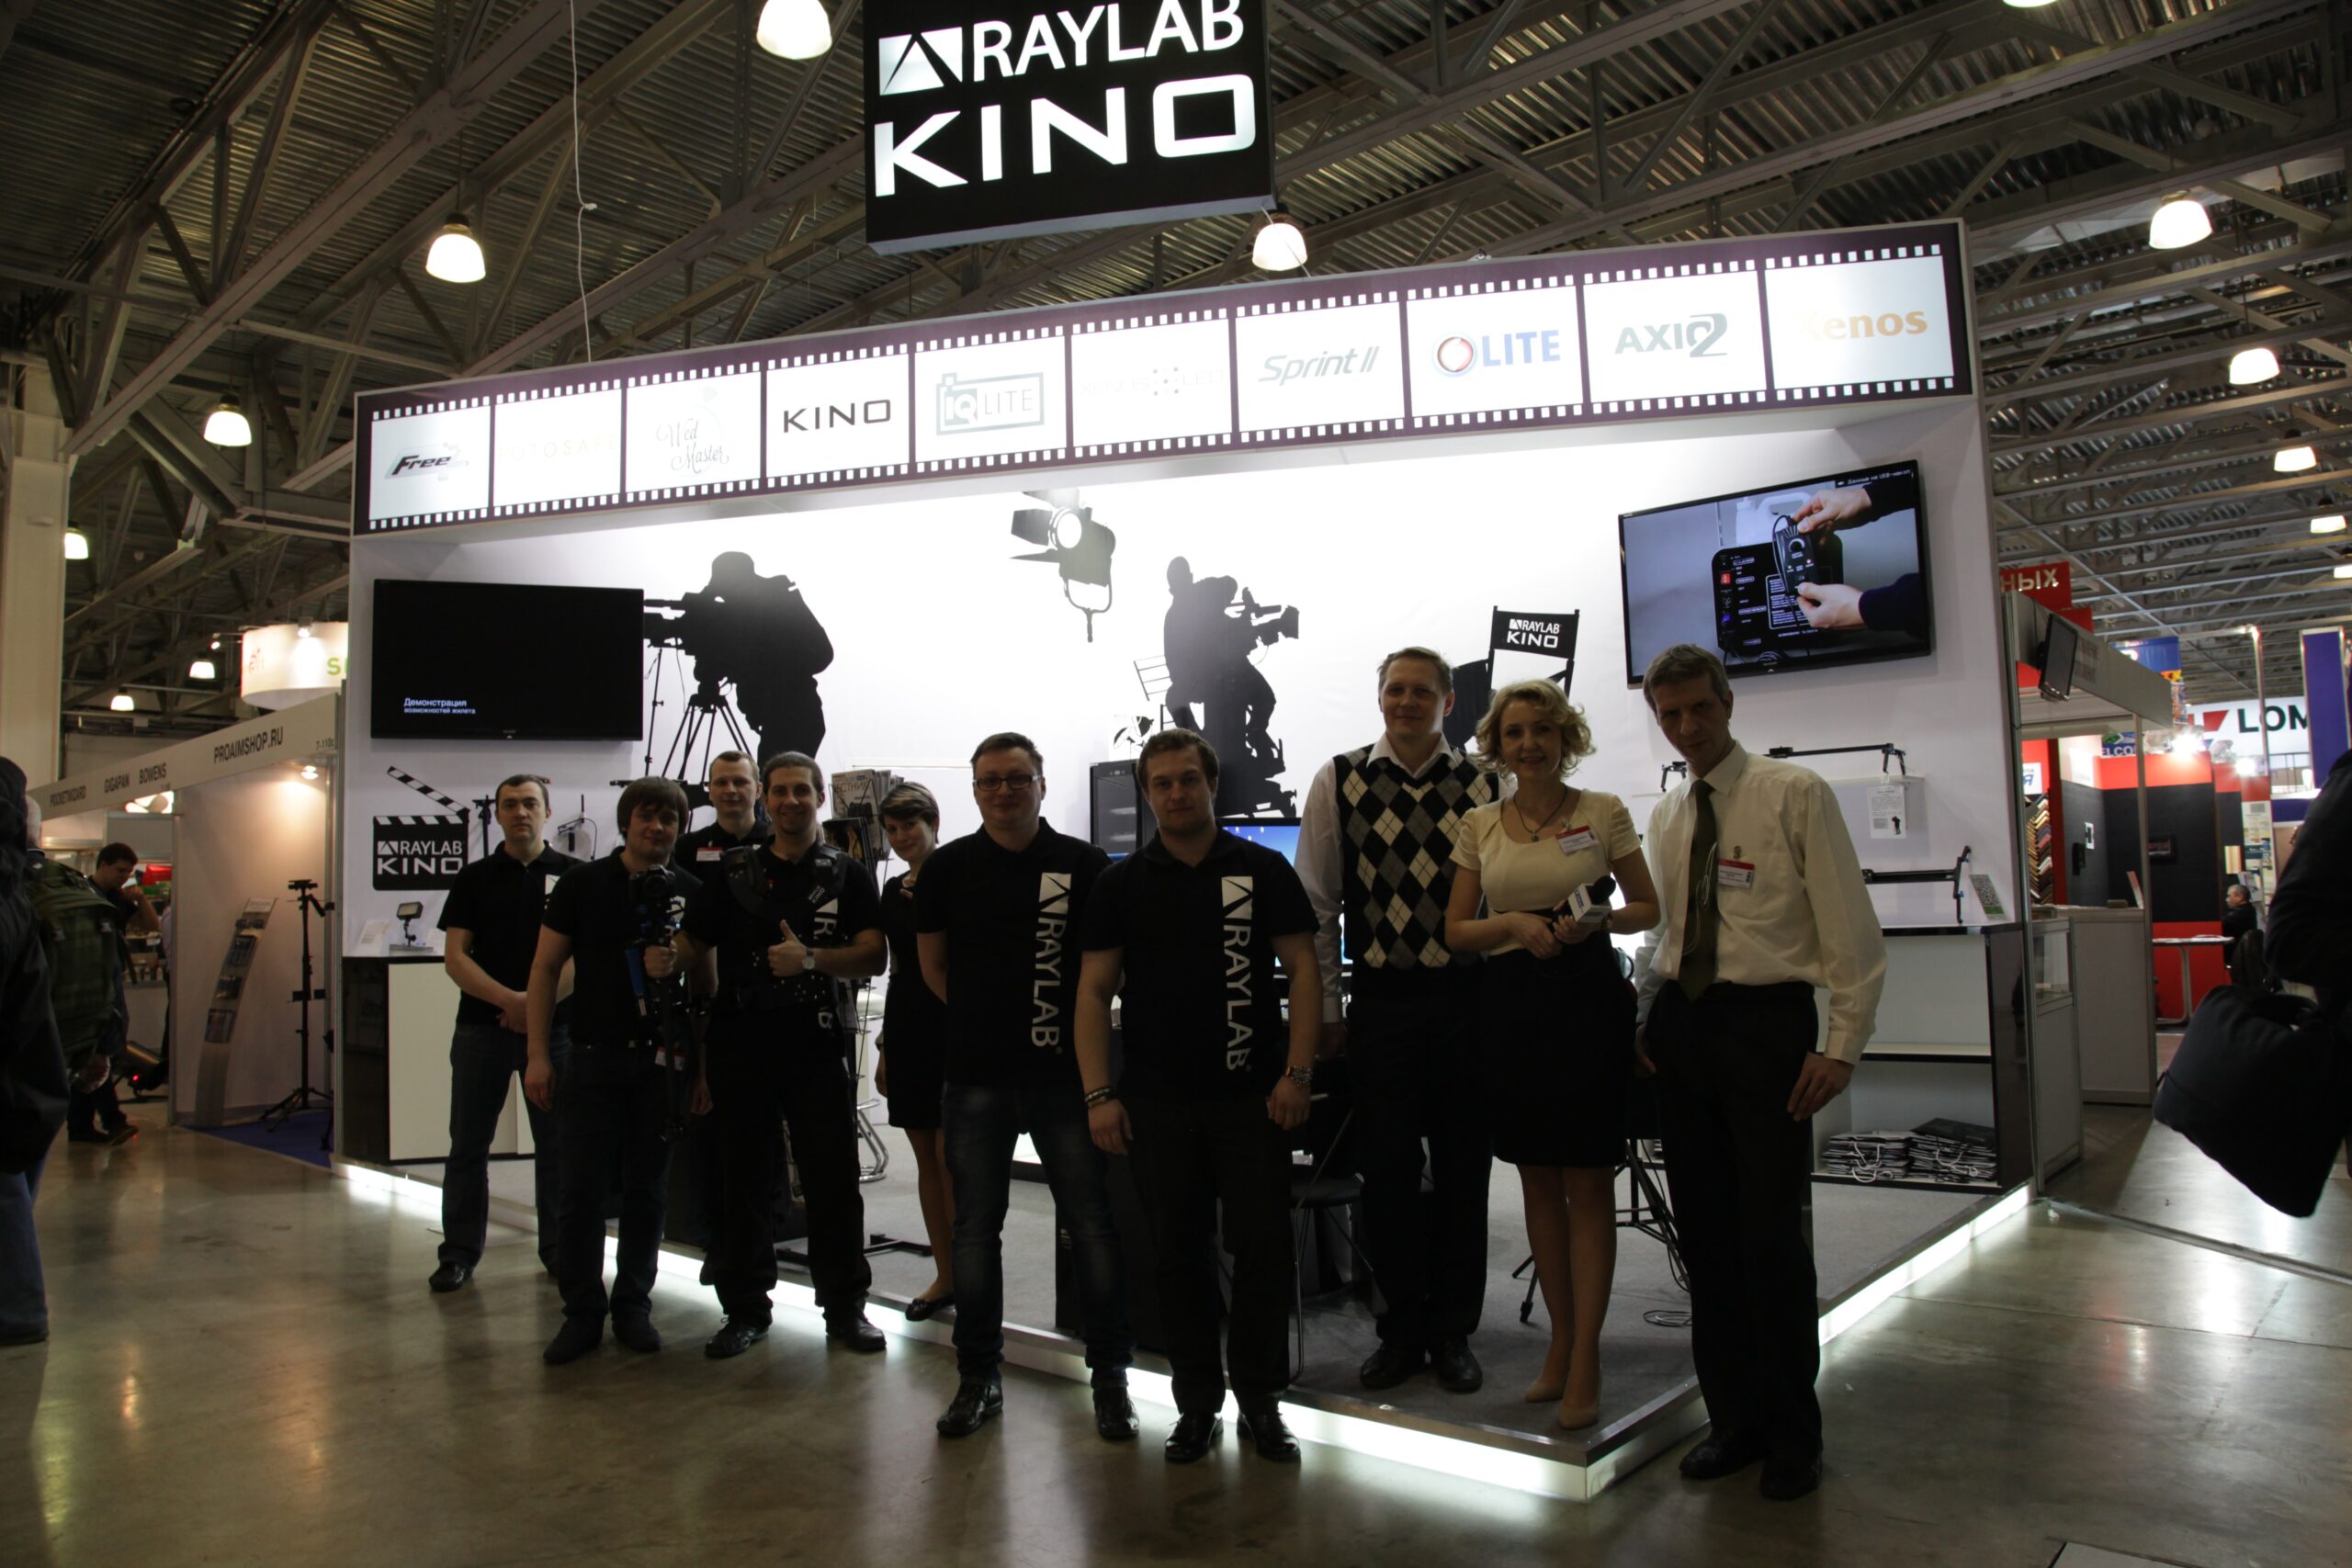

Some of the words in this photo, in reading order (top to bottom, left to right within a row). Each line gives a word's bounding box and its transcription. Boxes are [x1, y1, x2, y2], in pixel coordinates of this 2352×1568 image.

[973, 0, 1244, 83] RAYLAB
[874, 73, 1257, 197] KINO
[1259, 349, 1359, 386] Sprint
[783, 399, 892, 434] KINO
[656, 418, 700, 447] Wed
[671, 442, 729, 474] Master
[1507, 630, 1559, 649] KINO
[1521, 619, 1560, 635] RAYLAB
[403, 697, 468, 707] Демонстрация
[403, 706, 451, 715] возможностей
[213, 726, 285, 764] PROAIMSHOP.RU
[139, 761, 167, 784] BOWENS
[400, 840, 463, 855] RAYLAB
[377, 857, 464, 874] KINO
[1031, 916, 1068, 1048] RAYLAB
[1223, 924, 1253, 1071] RAYLAB
